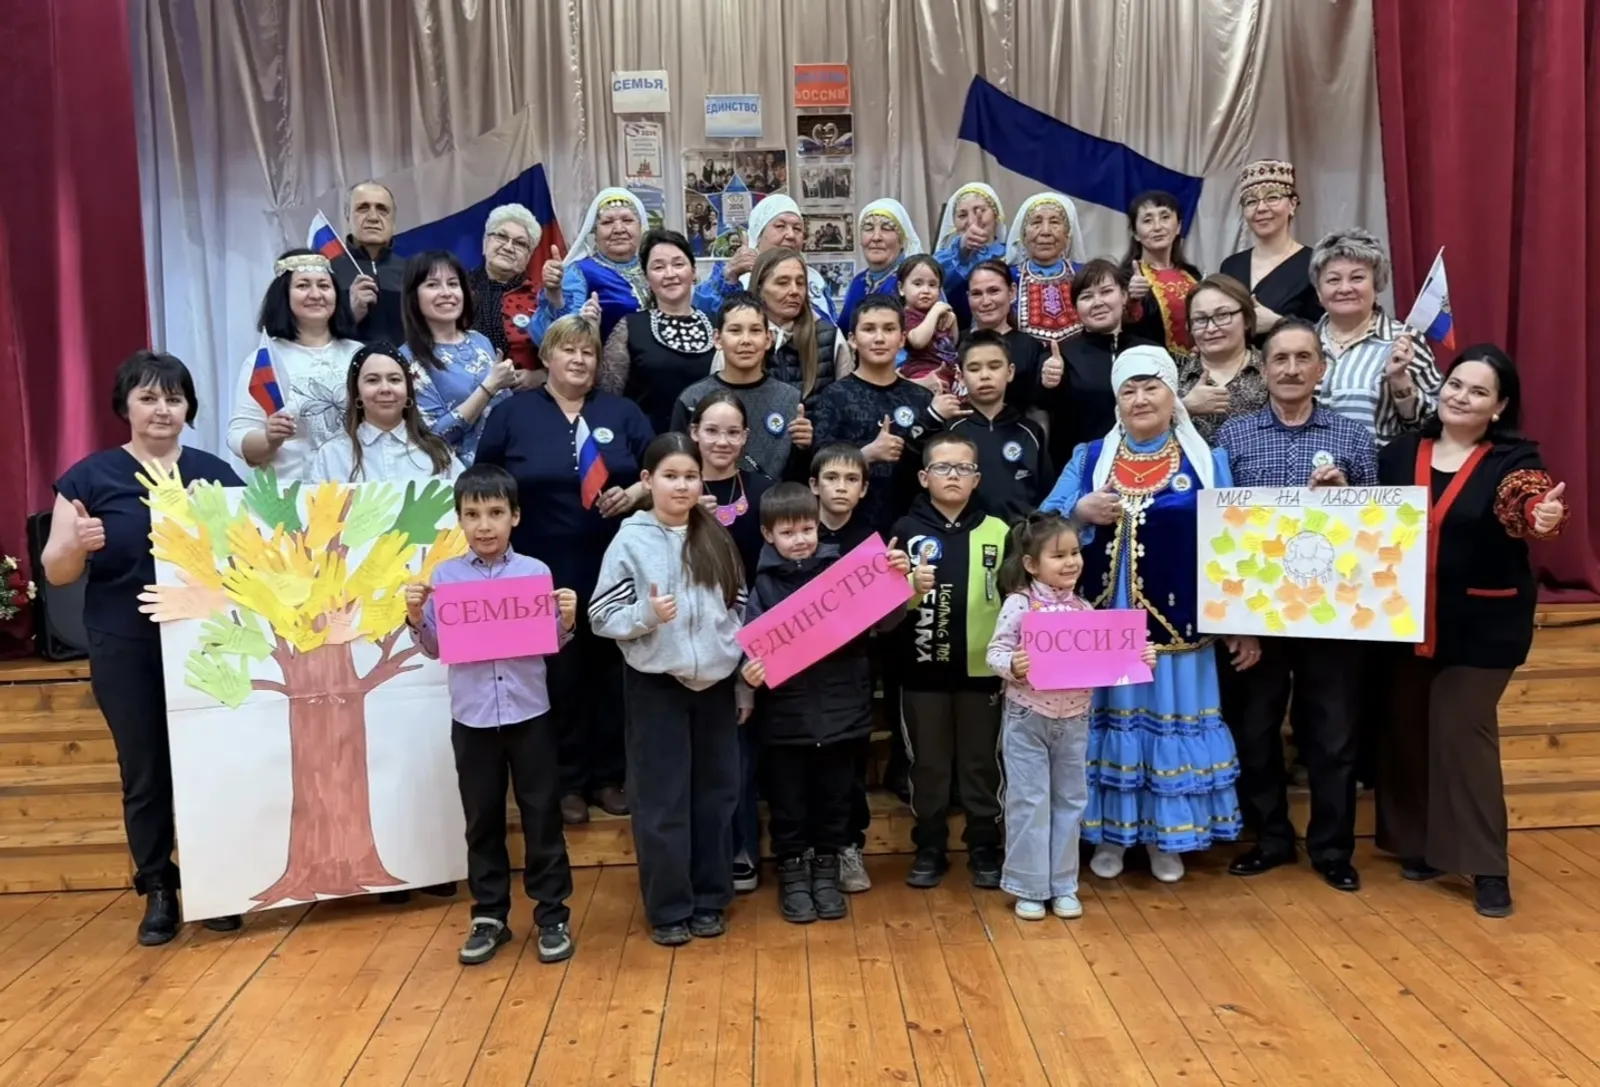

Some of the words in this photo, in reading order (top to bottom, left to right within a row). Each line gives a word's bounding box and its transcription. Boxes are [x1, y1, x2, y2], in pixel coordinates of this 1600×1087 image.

[1216, 489, 1252, 506] МИР
[1275, 489, 1301, 505] НА
[1321, 488, 1403, 505] ЛАДОШКЕ
[438, 593, 553, 626] СЕМЬЯ
[747, 551, 890, 658] ЕДИНСТВО
